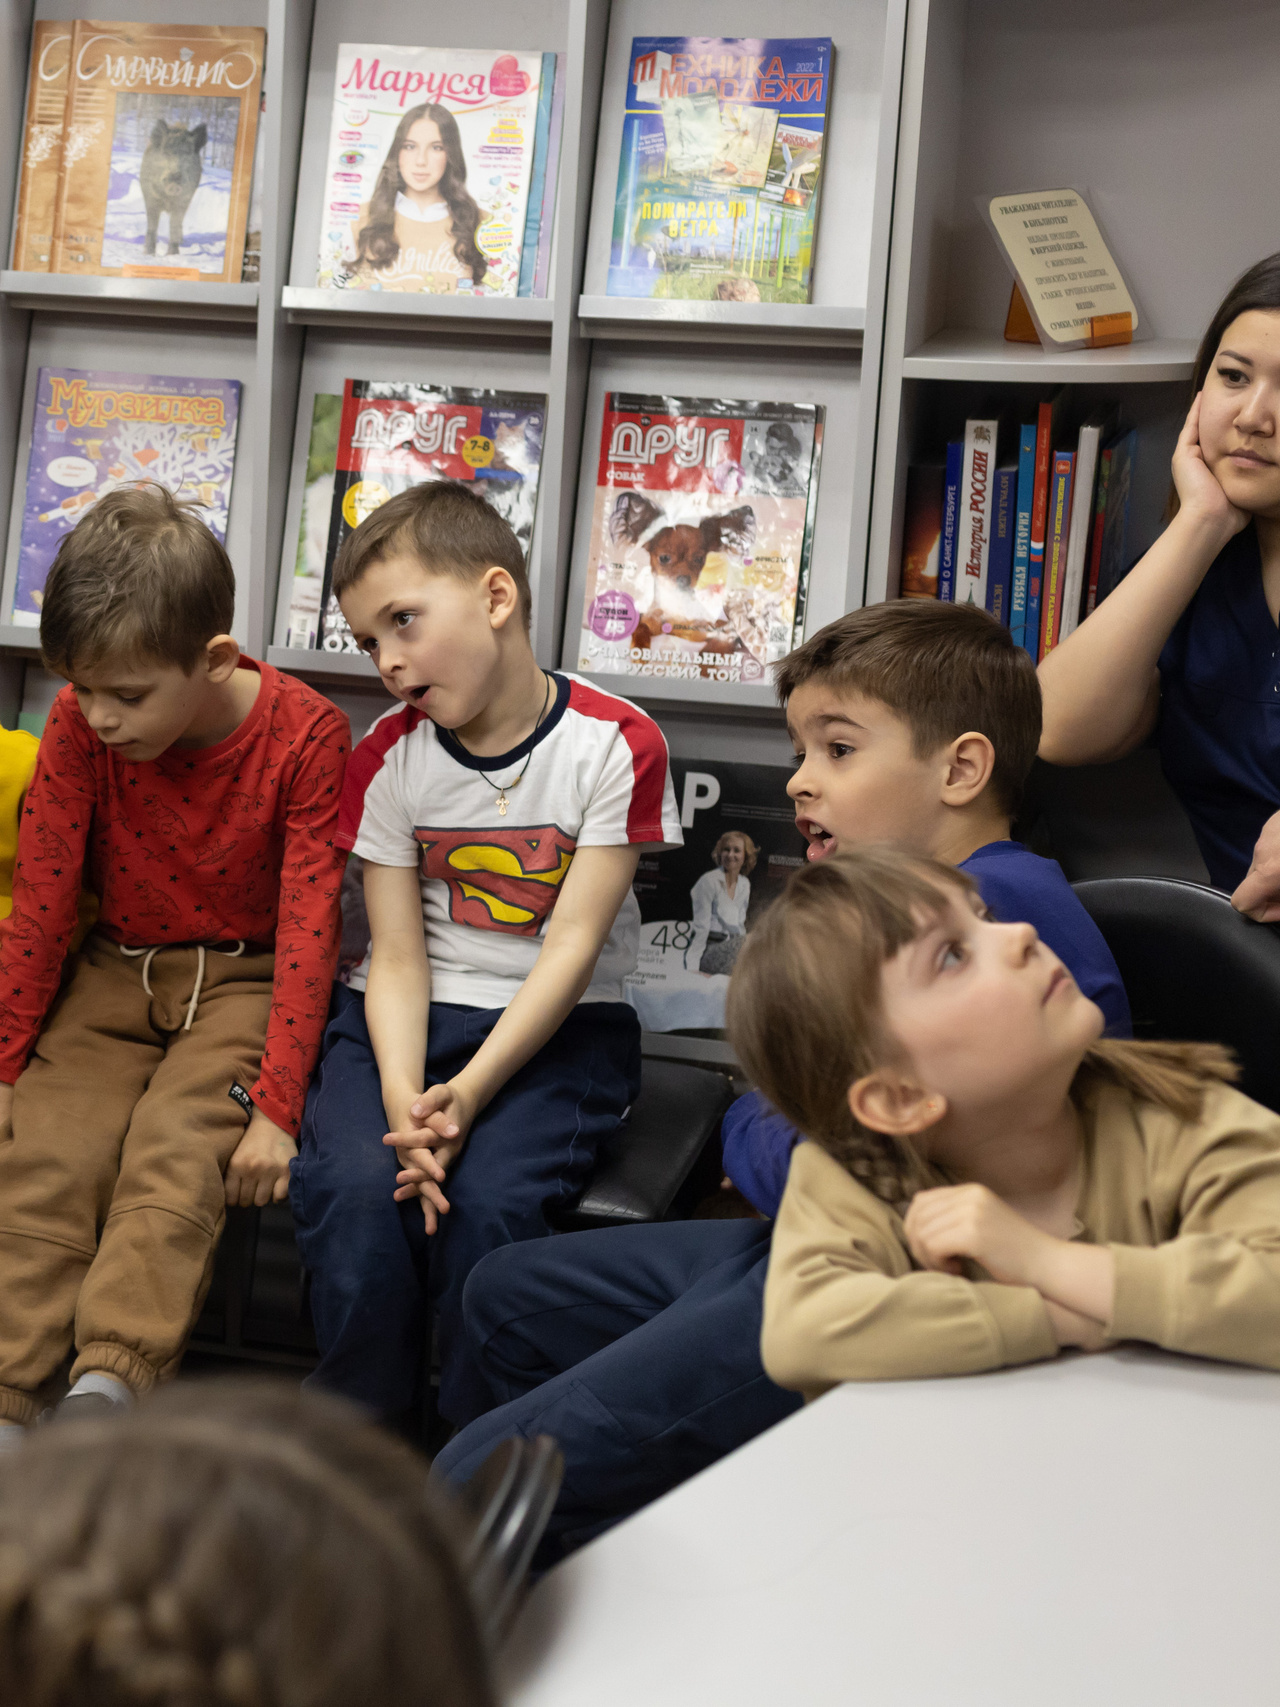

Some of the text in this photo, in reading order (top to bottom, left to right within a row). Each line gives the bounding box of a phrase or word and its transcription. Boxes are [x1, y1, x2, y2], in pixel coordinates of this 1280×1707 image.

[341, 57, 487, 107] Маруся
[660, 72, 824, 102] МОЛОДЕЖИ
[641, 200, 748, 220] ПОЖИРАТЕЛИ
[999, 203, 1041, 215] УВАЖАЕМЫЕ
[1029, 215, 1068, 227] БИБЛИОТЕКУ
[669, 220, 719, 238] ВЕТРА
[46, 377, 227, 428] Мурзилка
[351, 407, 468, 455] ДРУГ
[470, 439, 490, 452] 7-8
[607, 420, 730, 469] ДРУГ
[606, 470, 646, 483] СОБАК
[965, 449, 989, 579] История РОССИИ
[940, 485, 957, 603] ЕТЯМ О САНКТ-ПЕТЕРБУРГЕ
[1013, 512, 1030, 612] РУССКАЯ ИСТОРИЯ
[589, 646, 743, 667] ОЧАРОВАТЕЛЬНЫЙ
[624, 662, 741, 682] РУССКИЙ ТОЙ
[651, 920, 691, 954] 48
